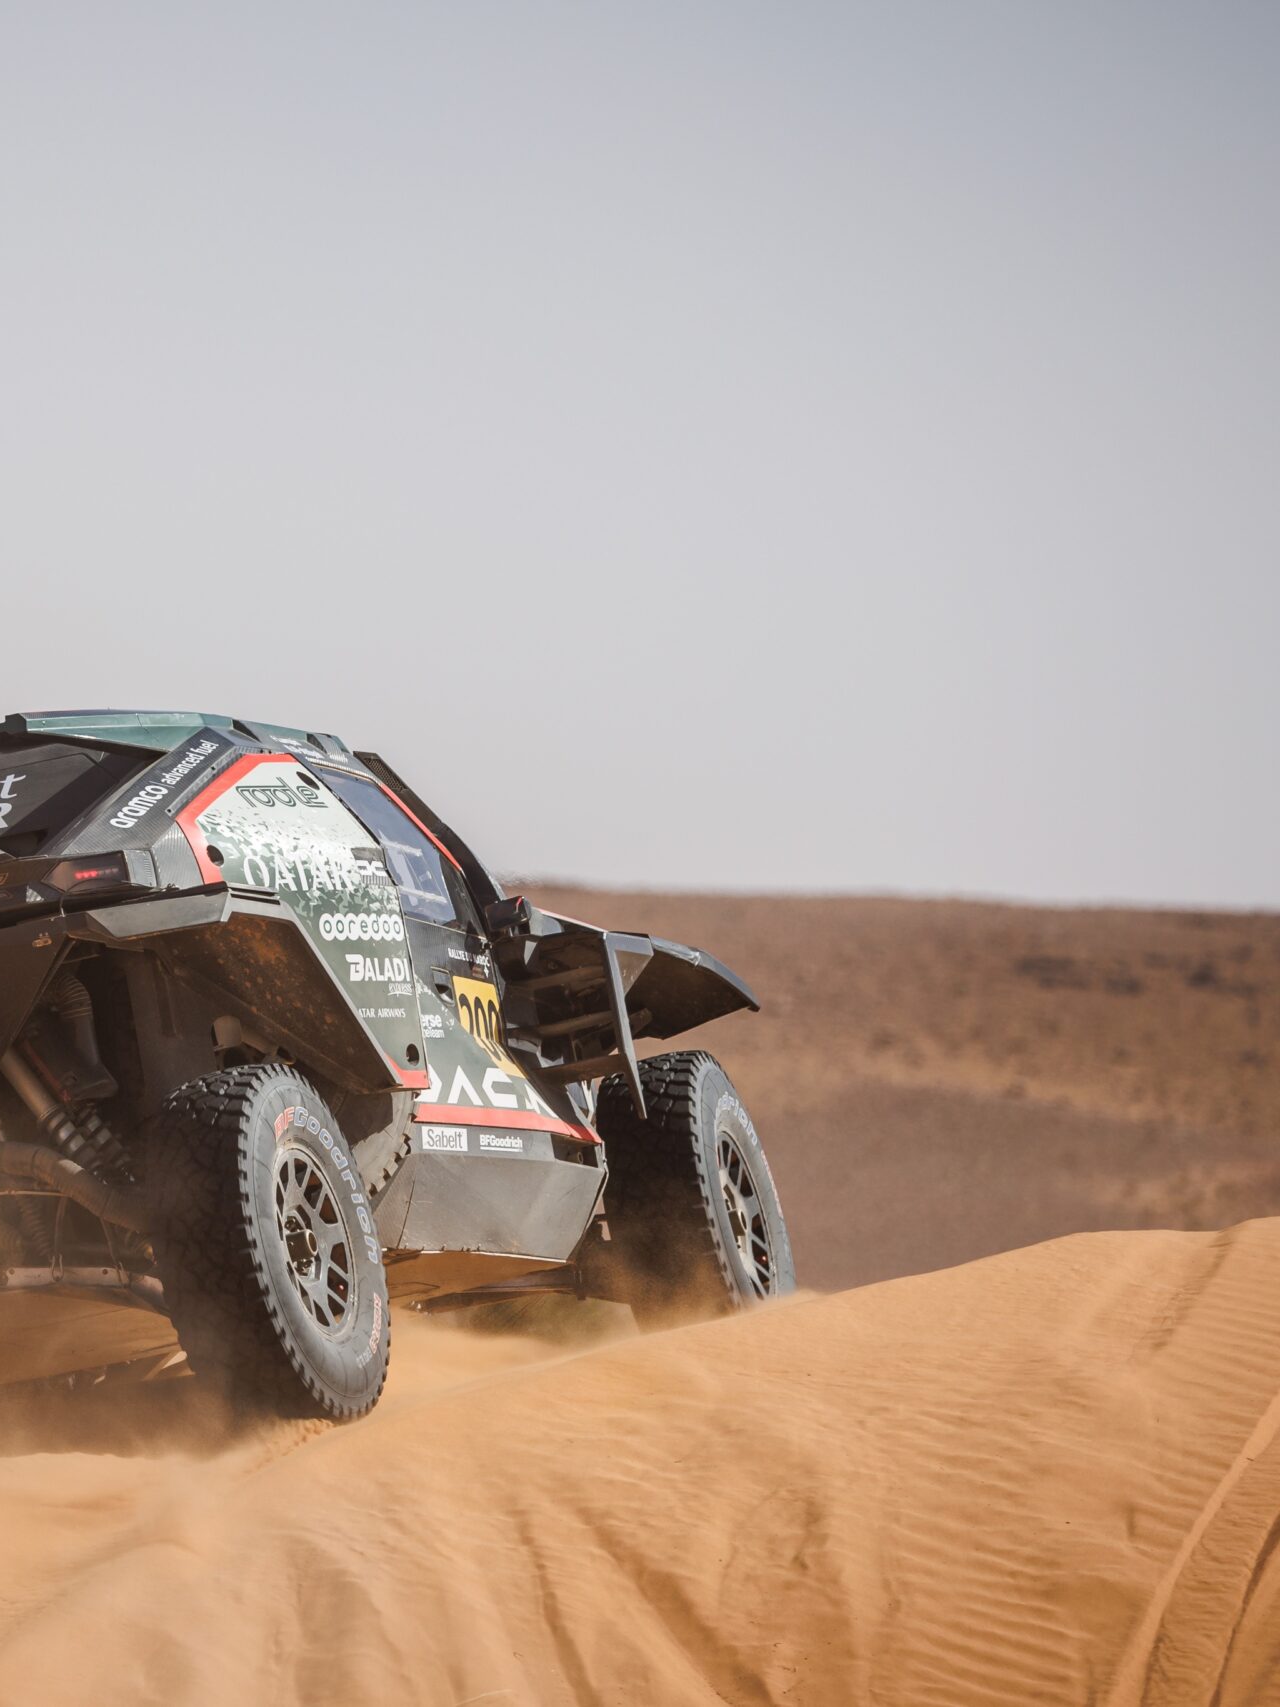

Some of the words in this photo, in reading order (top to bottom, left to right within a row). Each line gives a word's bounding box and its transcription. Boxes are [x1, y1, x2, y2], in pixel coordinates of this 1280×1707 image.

[109, 785, 168, 828] aramco
[161, 754, 206, 785] advanced
[190, 739, 220, 756] fuel
[320, 913, 404, 939] ooredoo
[345, 954, 410, 981] BALADI
[358, 1008, 376, 1018] ATAR
[378, 1008, 406, 1018] AIRWAYS
[420, 1014, 443, 1028] erse
[427, 1128, 464, 1149] Sabelt
[479, 1134, 523, 1148] BFGoodrich
[274, 1106, 380, 1264] BFGoodrich
